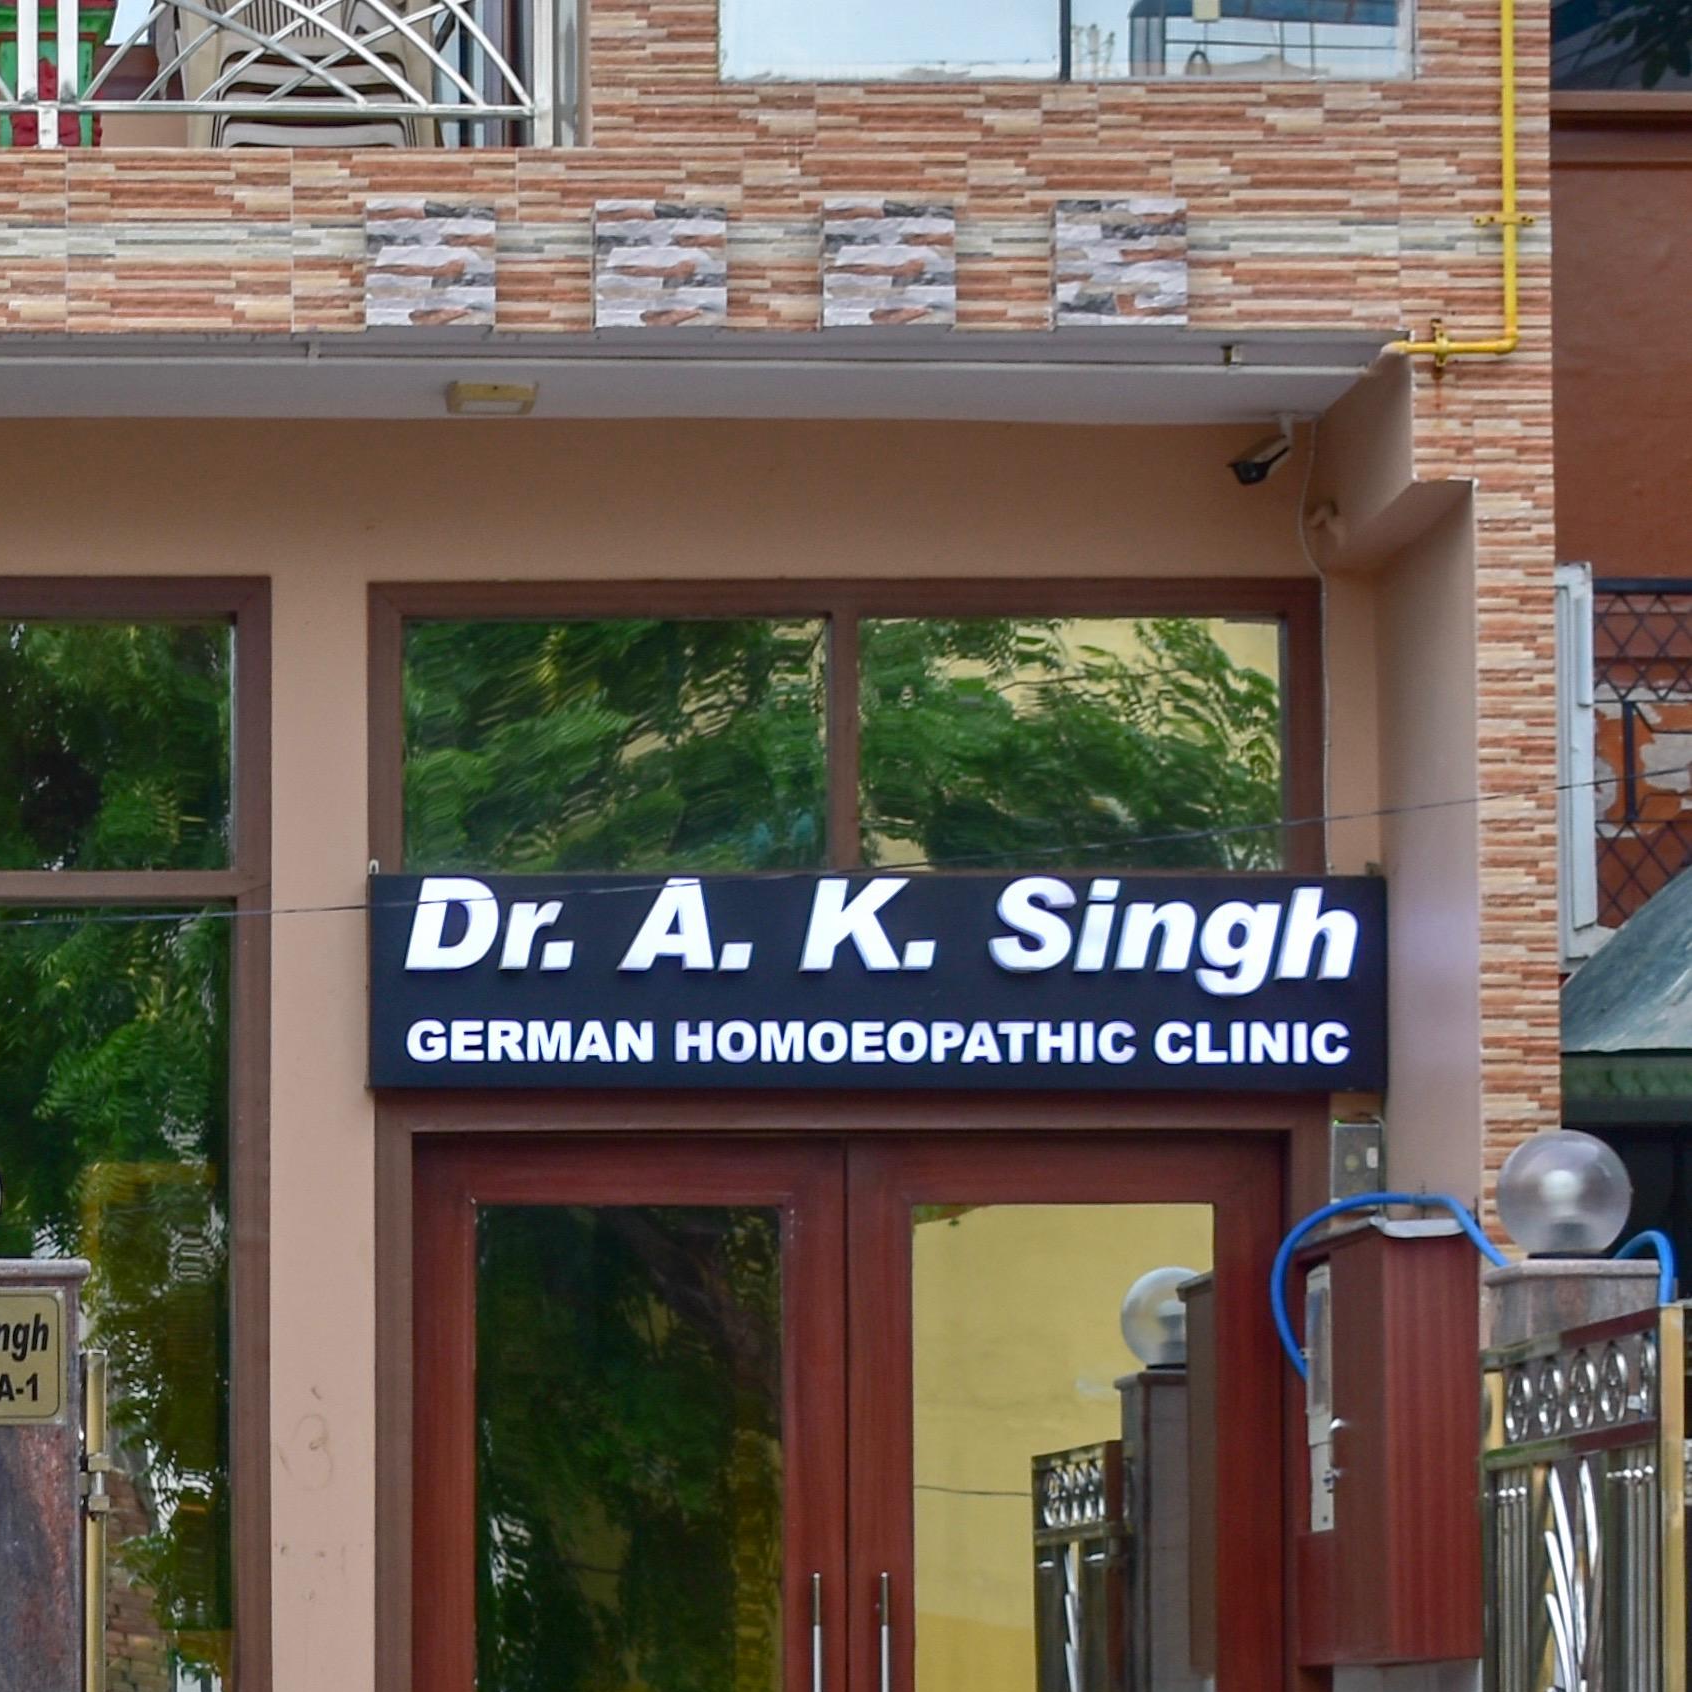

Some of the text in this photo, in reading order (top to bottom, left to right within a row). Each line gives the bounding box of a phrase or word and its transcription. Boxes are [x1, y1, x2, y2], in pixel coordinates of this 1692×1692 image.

[404, 875, 1360, 996] Dr. A. K. Singh
[405, 1018, 1351, 1065] GERMAN HOMOEOPATHIC CLINIC
